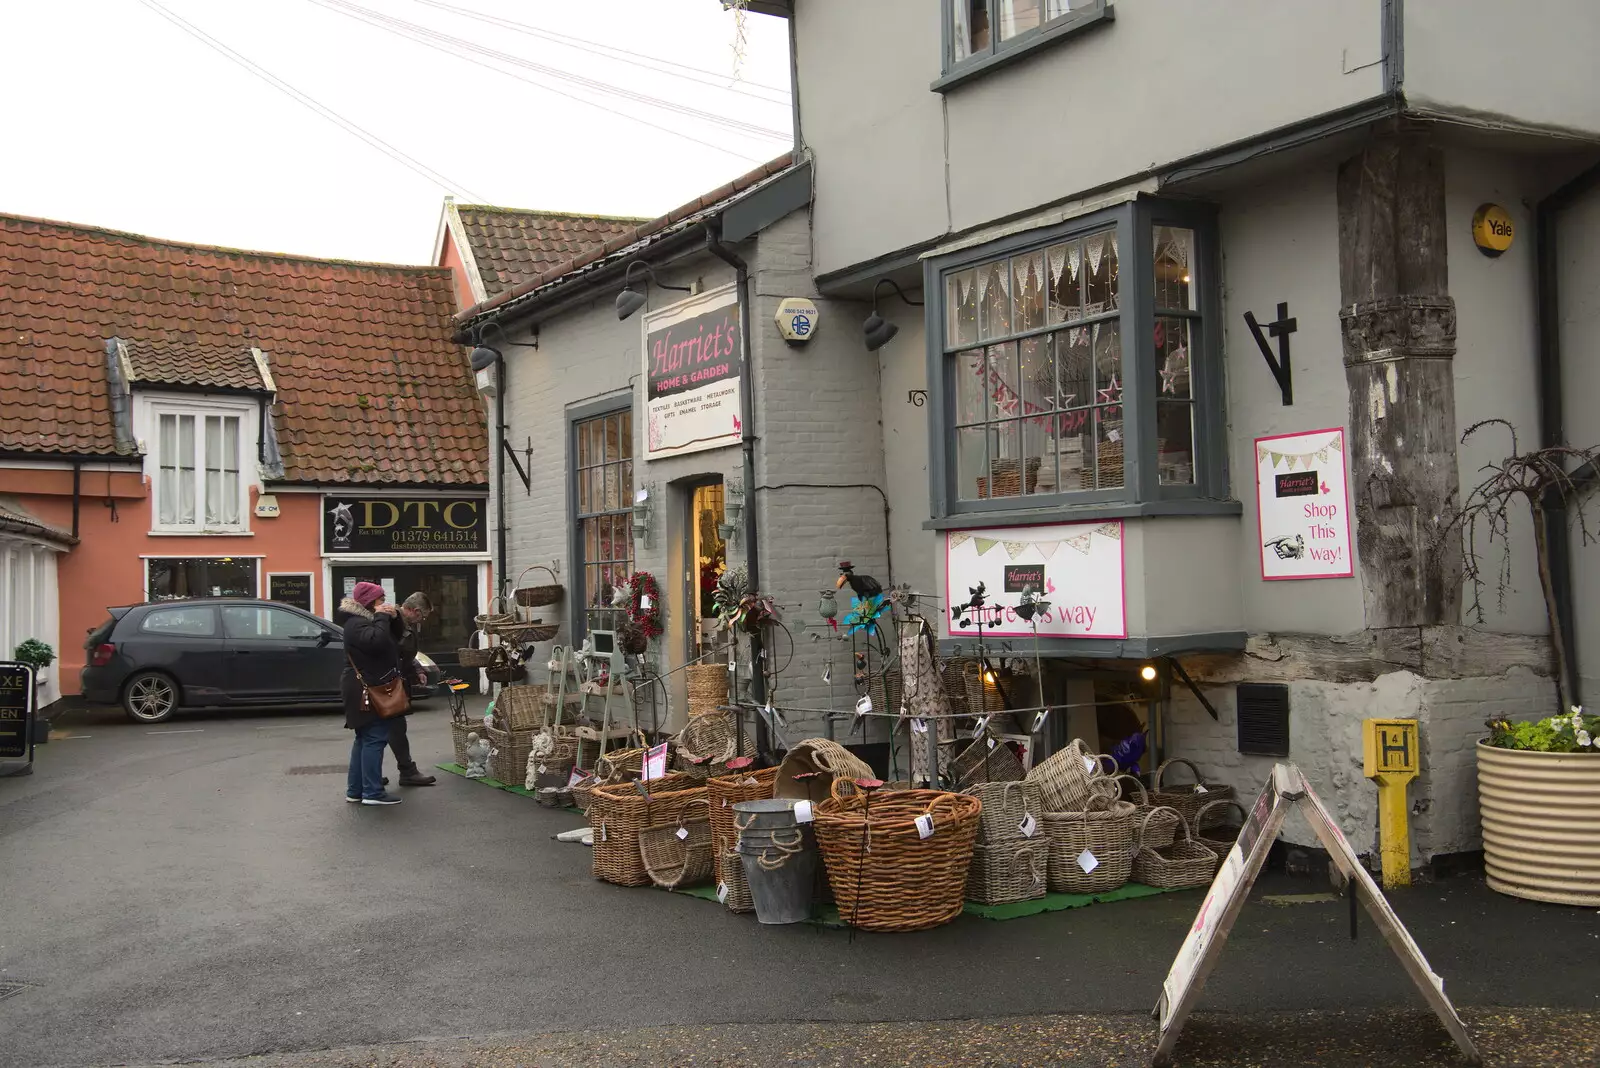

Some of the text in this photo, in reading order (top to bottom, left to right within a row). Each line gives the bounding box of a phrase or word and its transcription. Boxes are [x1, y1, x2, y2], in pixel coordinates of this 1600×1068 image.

[1488, 219, 1512, 236] Yale
[651, 316, 735, 377] Harriet's
[656, 363, 729, 392] HOME & GARDEN
[674, 395, 703, 408] BASKETWARE
[706, 387, 736, 400] METALWORK
[700, 400, 722, 411] STORAGE
[1280, 476, 1315, 489] Harriet's
[358, 500, 478, 529] DTC
[1303, 502, 1338, 520] Shop
[391, 530, 478, 542] 01379 641514
[1308, 524, 1336, 540] This
[391, 542, 478, 550] disstrophycentre.co.uk
[1309, 546, 1342, 565] Way!
[1007, 568, 1042, 582] Harriet's
[1058, 604, 1097, 631] way
[1392, 734, 1398, 743] 4
[1381, 731, 1409, 767] H
